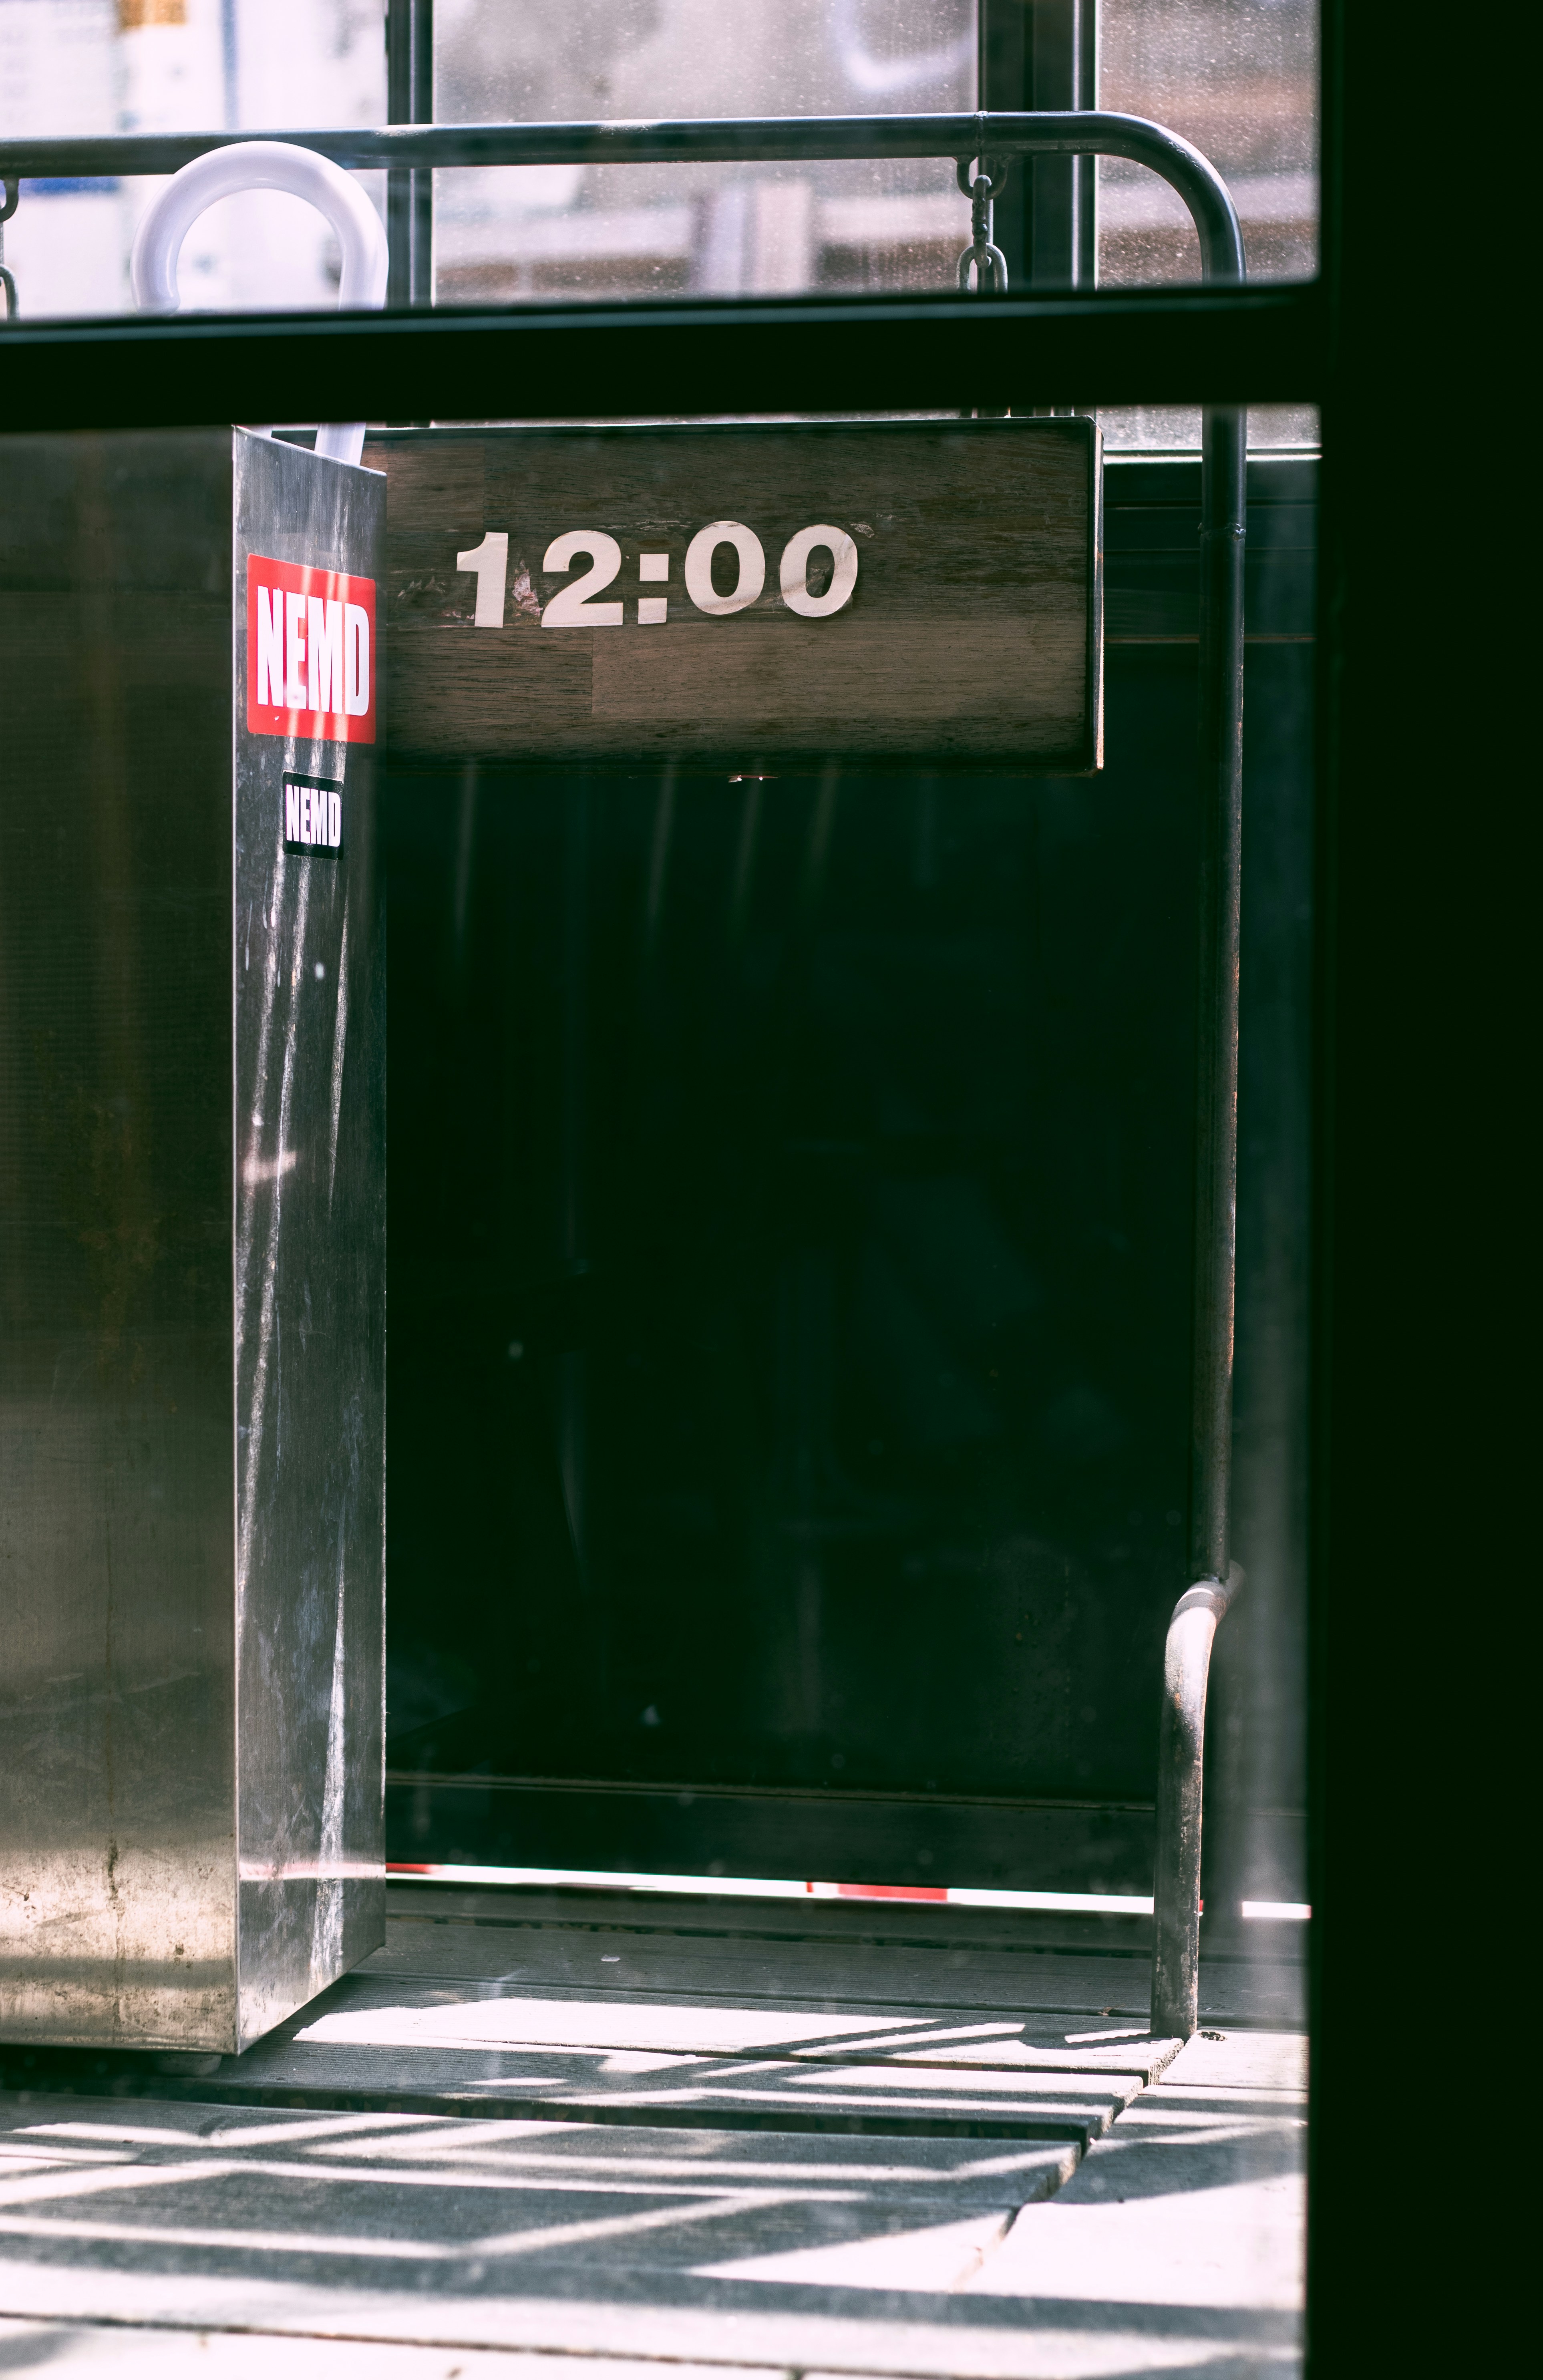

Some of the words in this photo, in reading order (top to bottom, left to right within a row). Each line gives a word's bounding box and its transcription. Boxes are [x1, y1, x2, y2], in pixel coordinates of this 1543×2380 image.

[457, 520, 858, 628] 12:00
[257, 585, 370, 716] NEMD
[285, 784, 341, 847] NEMD
